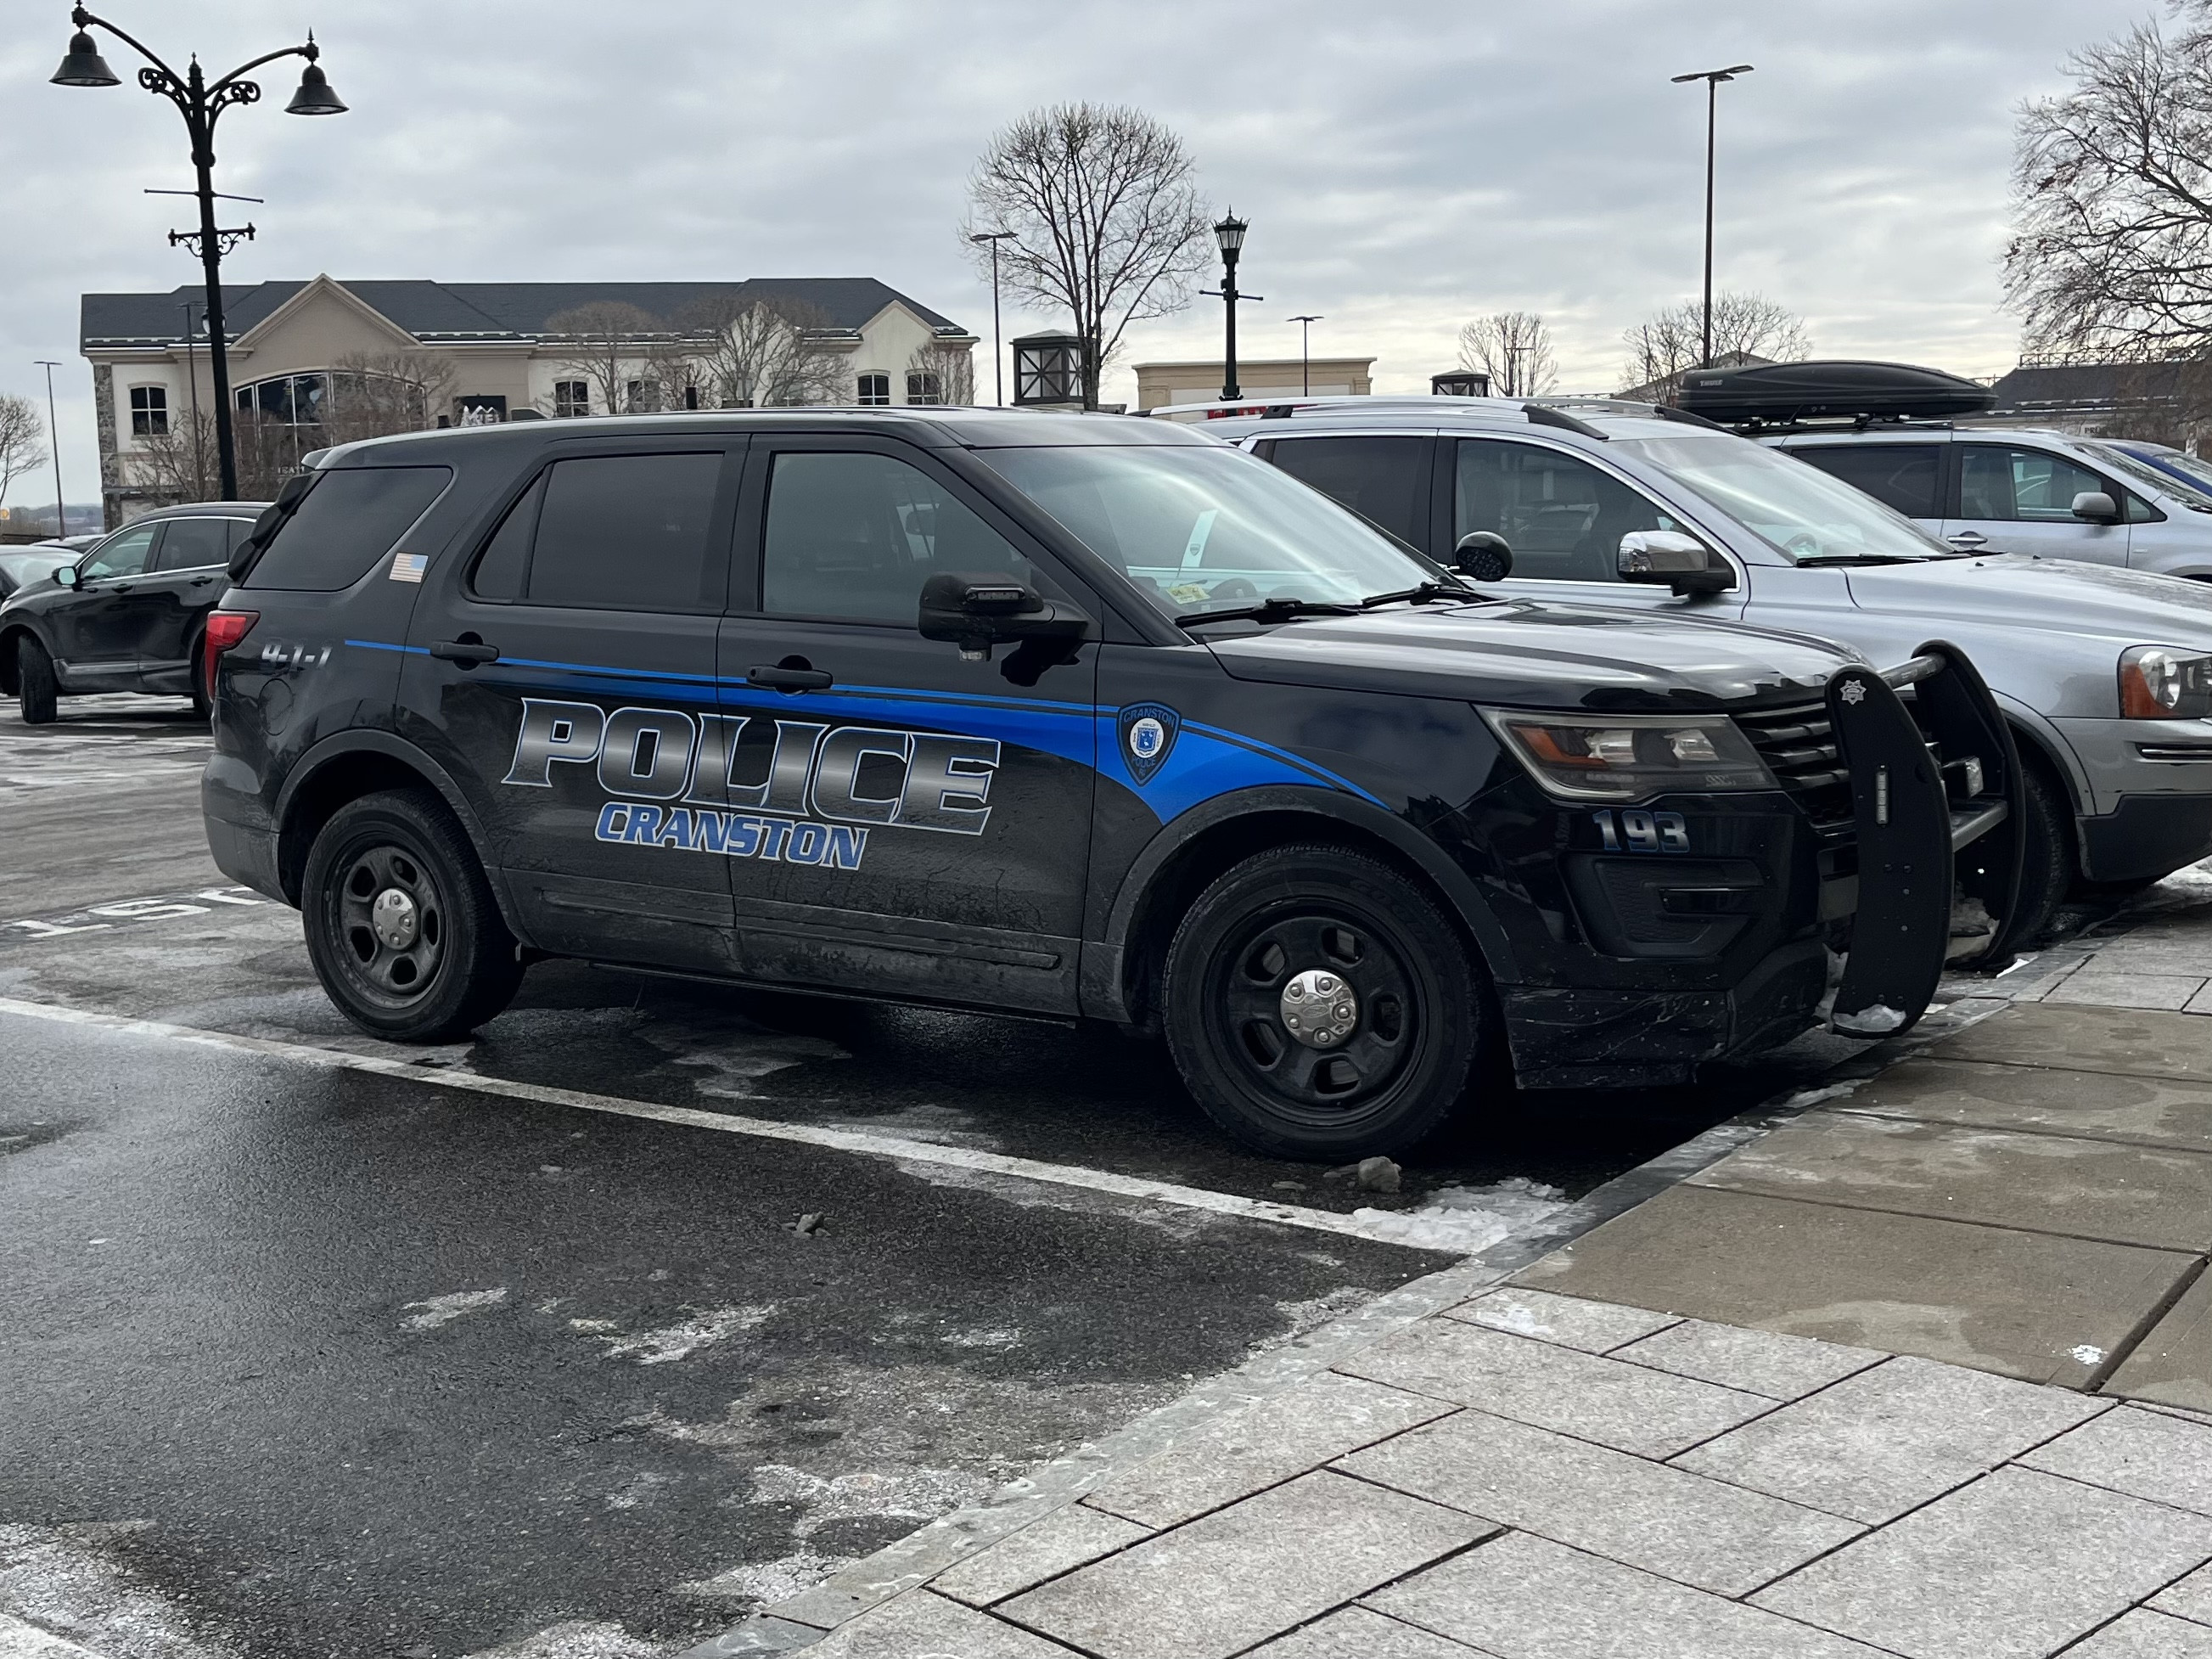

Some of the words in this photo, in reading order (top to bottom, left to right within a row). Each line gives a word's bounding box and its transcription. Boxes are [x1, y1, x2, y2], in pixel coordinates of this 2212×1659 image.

[1123, 706, 1176, 728] CRANSTON
[502, 698, 1001, 835] POLICE
[1131, 754, 1156, 768] POLICE
[594, 801, 869, 869] CRANSTON
[1592, 809, 1691, 853] 193
